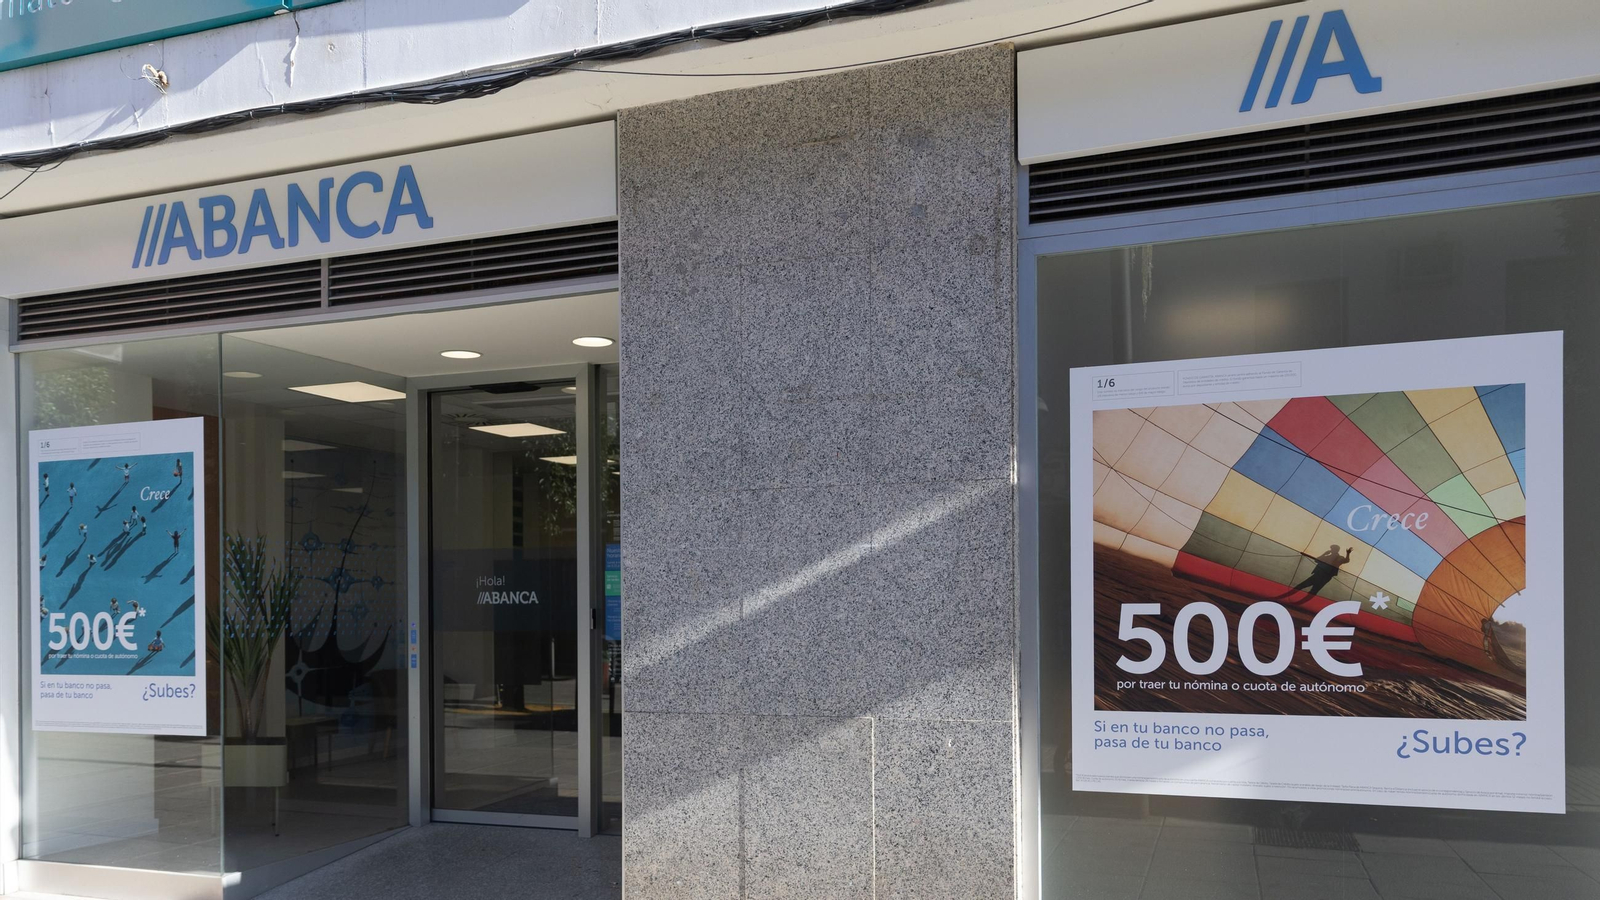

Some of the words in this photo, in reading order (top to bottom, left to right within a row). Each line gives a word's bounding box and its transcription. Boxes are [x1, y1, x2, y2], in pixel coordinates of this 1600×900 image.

[1097, 378, 1116, 389] 1/6
[140, 486, 171, 502] Crece
[1346, 503, 1430, 534] Crece
[476, 575, 505, 588] ¡Hola!
[40, 681, 46, 689] Si
[64, 682, 84, 690] banco
[142, 683, 196, 701] ¿Subes?
[1116, 681, 1136, 691] por
[1139, 680, 1166, 689] traer
[1169, 680, 1180, 690] tu
[1184, 680, 1228, 690] nómina
[1231, 682, 1240, 691] o
[1243, 681, 1277, 691] cuota
[1280, 681, 1296, 692] de
[1299, 681, 1366, 693] autónomo
[56, 691, 64, 699] de
[73, 691, 93, 699] banco
[1094, 720, 1106, 732] Si
[1110, 723, 1129, 733] en
[1133, 722, 1148, 733] tu
[1153, 722, 1200, 735] banco
[1205, 726, 1225, 736] no
[1230, 726, 1269, 739] pasa,
[1094, 738, 1127, 750] pasa
[1131, 737, 1150, 749] de
[1154, 739, 1169, 750] tu
[1174, 738, 1222, 752] banco
[1396, 730, 1527, 760] ¿Subes?
